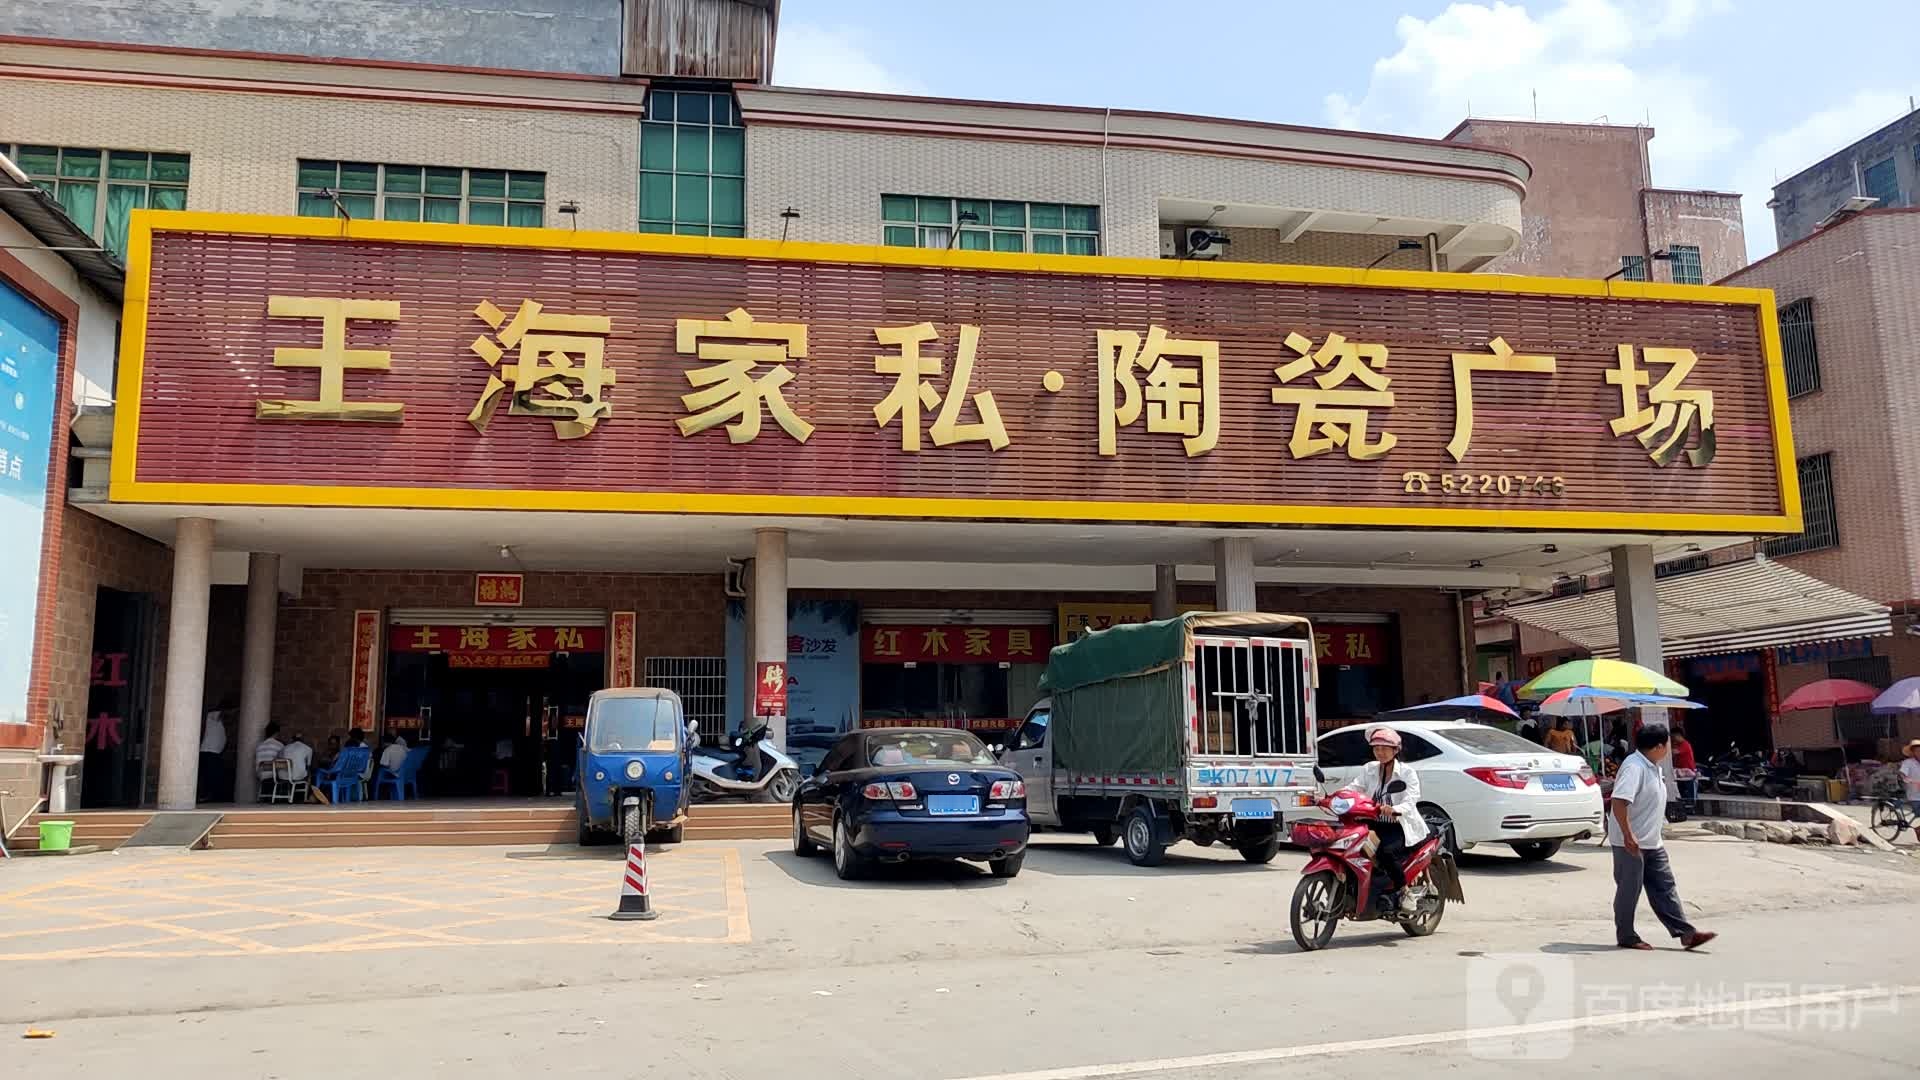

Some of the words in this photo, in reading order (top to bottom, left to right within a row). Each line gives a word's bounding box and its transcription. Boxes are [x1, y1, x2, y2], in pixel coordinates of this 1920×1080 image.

[1441, 473, 1566, 497] 5220746
[873, 628, 1033, 657] 红木家具
